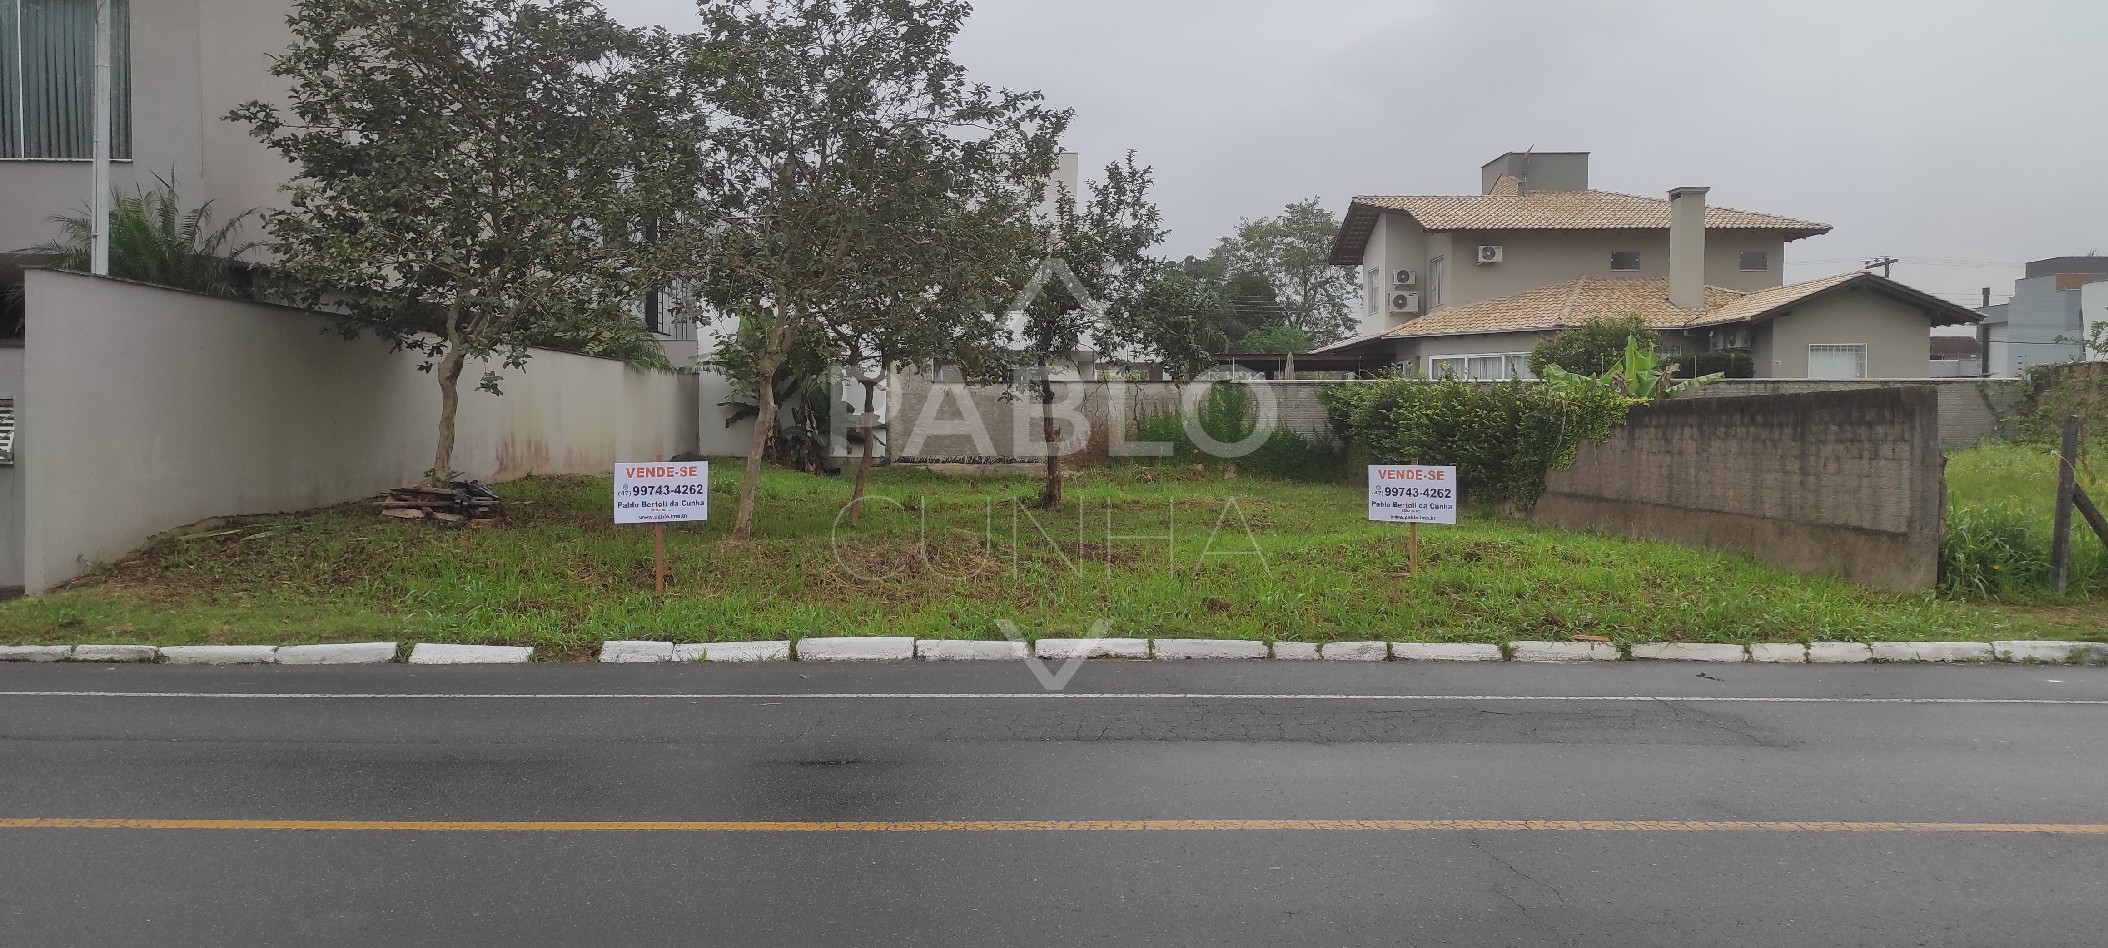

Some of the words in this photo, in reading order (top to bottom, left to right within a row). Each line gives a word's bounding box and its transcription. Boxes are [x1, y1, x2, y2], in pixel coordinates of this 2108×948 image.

[625, 465, 697, 478] VENDE-SE
[1378, 469, 1444, 480] VENDE-SE
[633, 484, 703, 496] 99743-4262
[1385, 487, 1451, 498] 99743-4262
[618, 501, 639, 509] Pablo
[682, 499, 705, 507] Cunha
